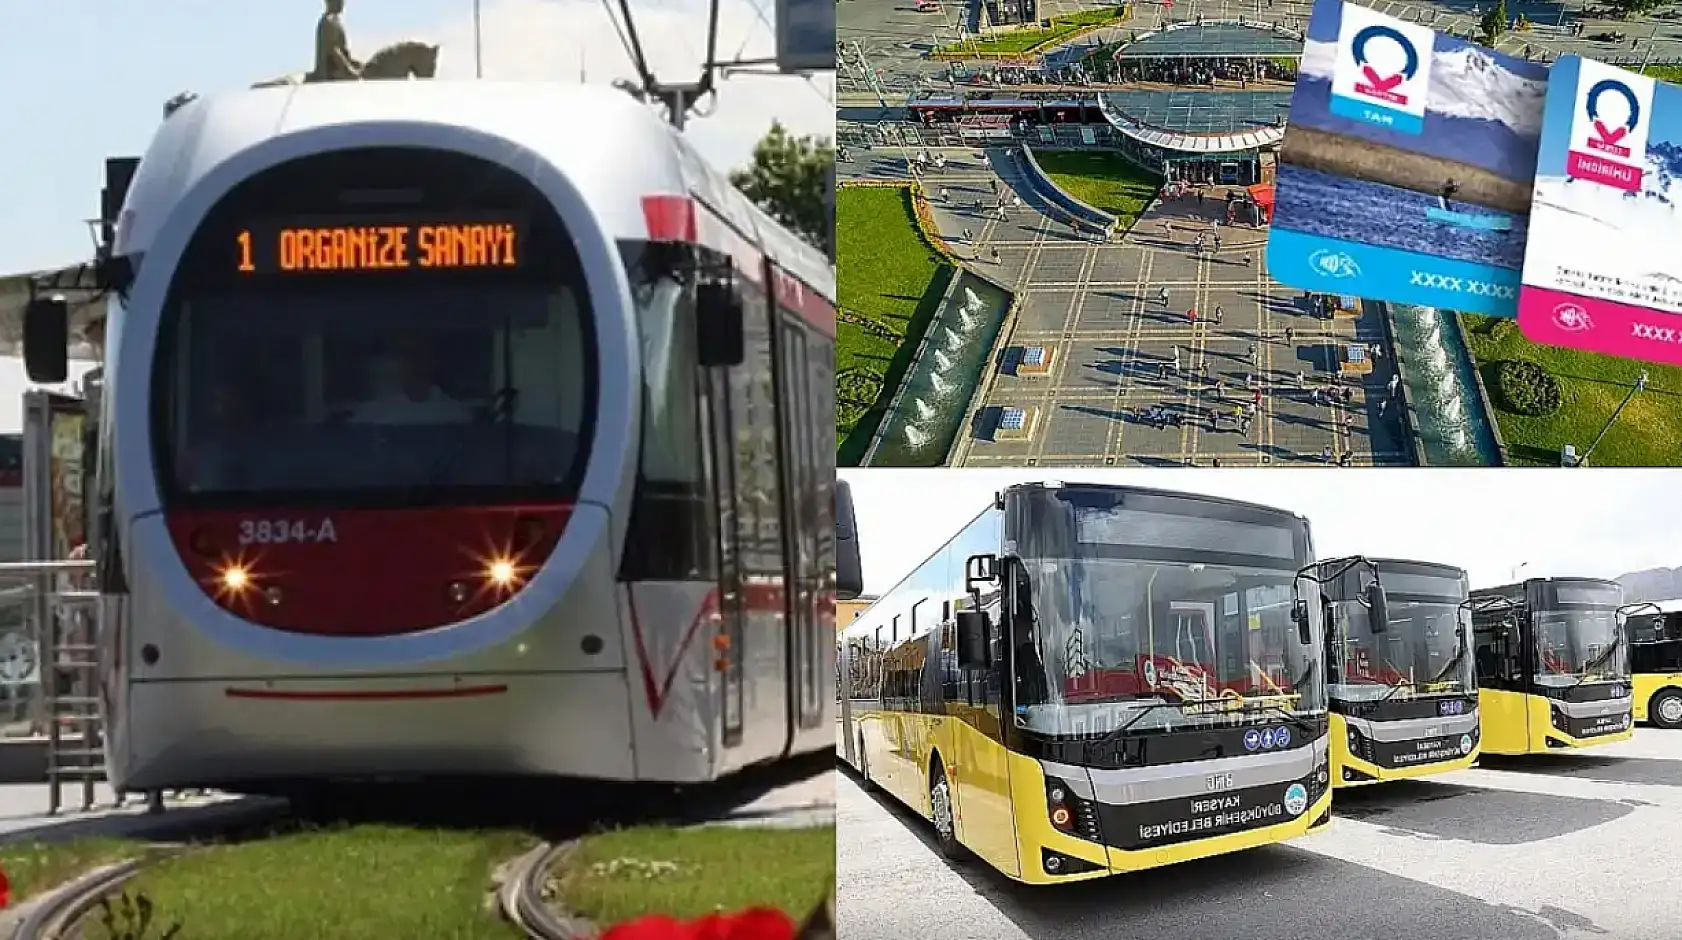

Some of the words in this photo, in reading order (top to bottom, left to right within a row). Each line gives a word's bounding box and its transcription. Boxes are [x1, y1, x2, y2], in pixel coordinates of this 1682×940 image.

[237, 230, 255, 271] 1
[279, 227, 410, 270] ORGANİZE
[417, 223, 516, 266] SANAYİ
[1410, 269, 1463, 292] XXXX
[1467, 280, 1515, 299] XXXX
[1631, 321, 1674, 343] XXXX
[238, 516, 338, 544] 3834-A
